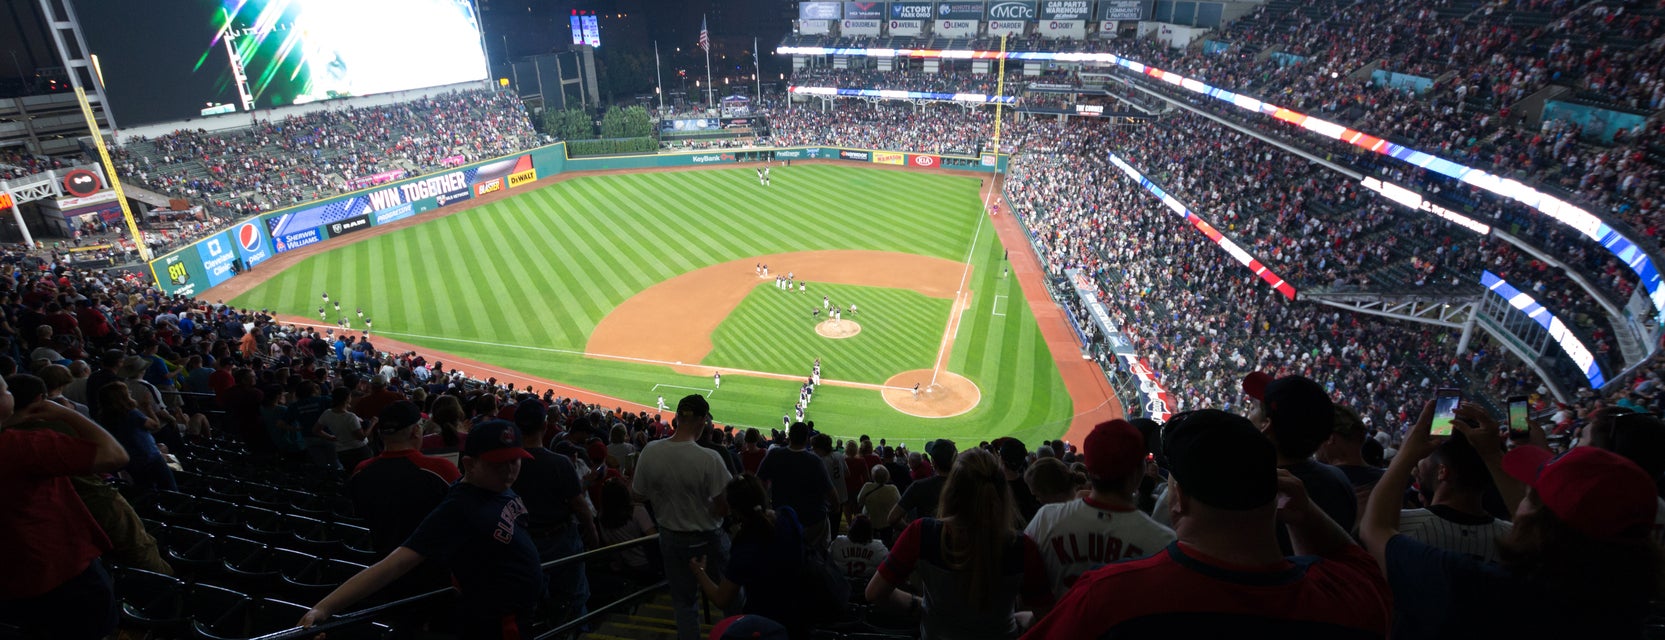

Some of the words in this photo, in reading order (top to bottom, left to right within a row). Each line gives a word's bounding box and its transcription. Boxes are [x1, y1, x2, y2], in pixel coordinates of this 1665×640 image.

[996, 6, 1033, 18] MCPc
[693, 154, 720, 163] KeyBank
[917, 157, 931, 165] KIA
[369, 187, 402, 211] WIN
[400, 171, 468, 202] TOGETHER
[377, 205, 413, 223] PROGRESSIVE
[343, 219, 366, 229] RAM
[285, 229, 316, 243] SHERWIN
[204, 249, 235, 270] Cleveland
[248, 250, 265, 264] pepsi
[168, 262, 187, 281] 811
[842, 546, 874, 561] LINDOR
